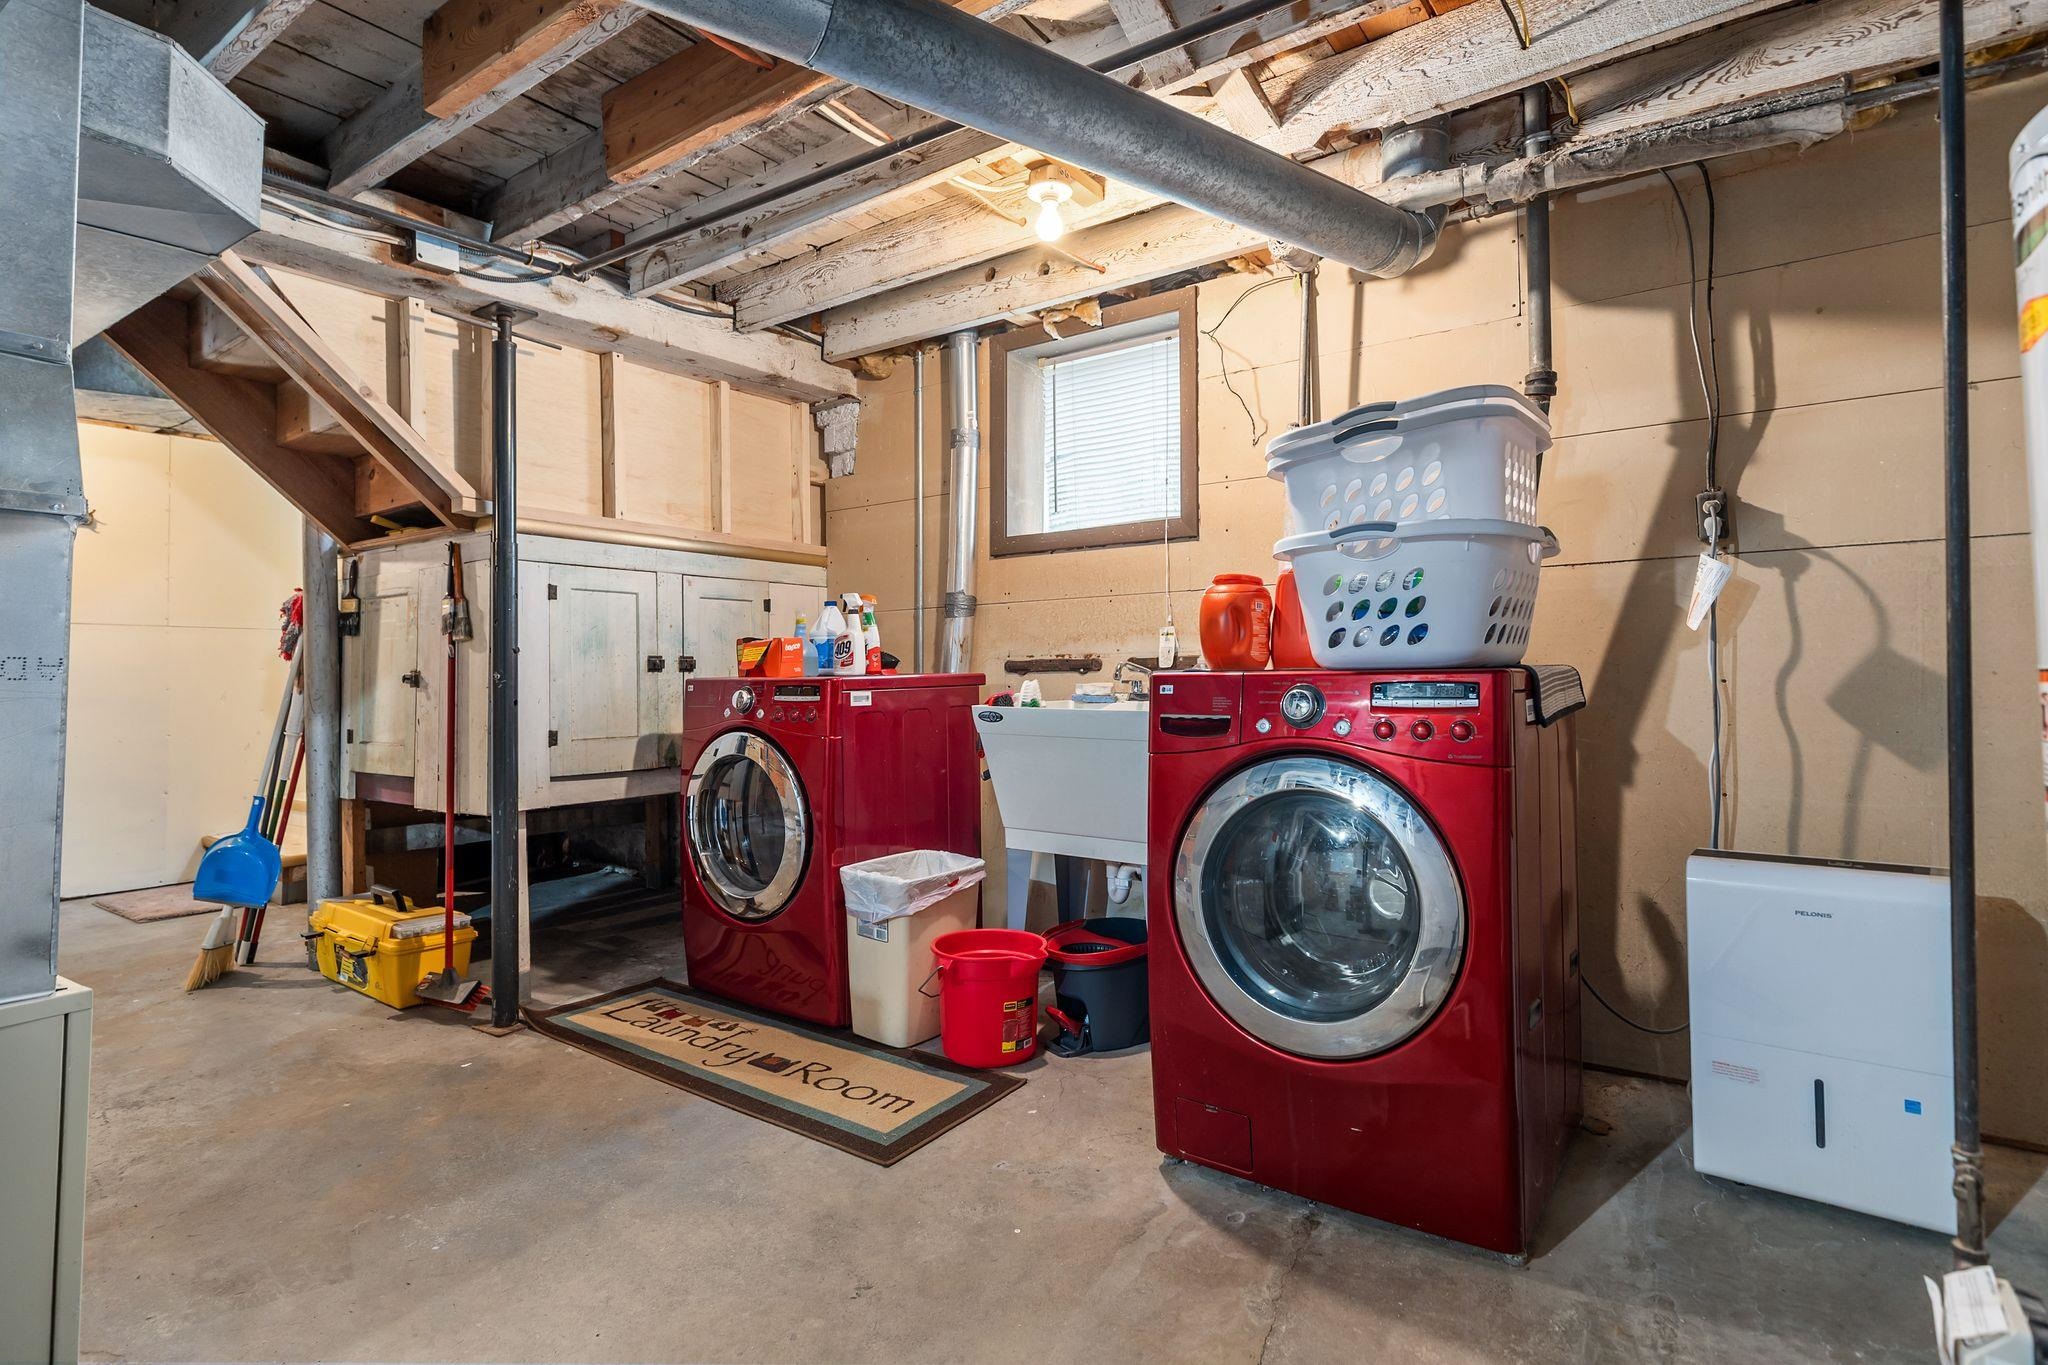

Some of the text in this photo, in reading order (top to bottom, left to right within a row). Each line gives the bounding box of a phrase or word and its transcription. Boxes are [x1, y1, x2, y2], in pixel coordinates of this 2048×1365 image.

[835, 640, 851, 656] 409
[1794, 910, 1832, 918] PELONIS
[601, 998, 915, 1113] Laundry Room
